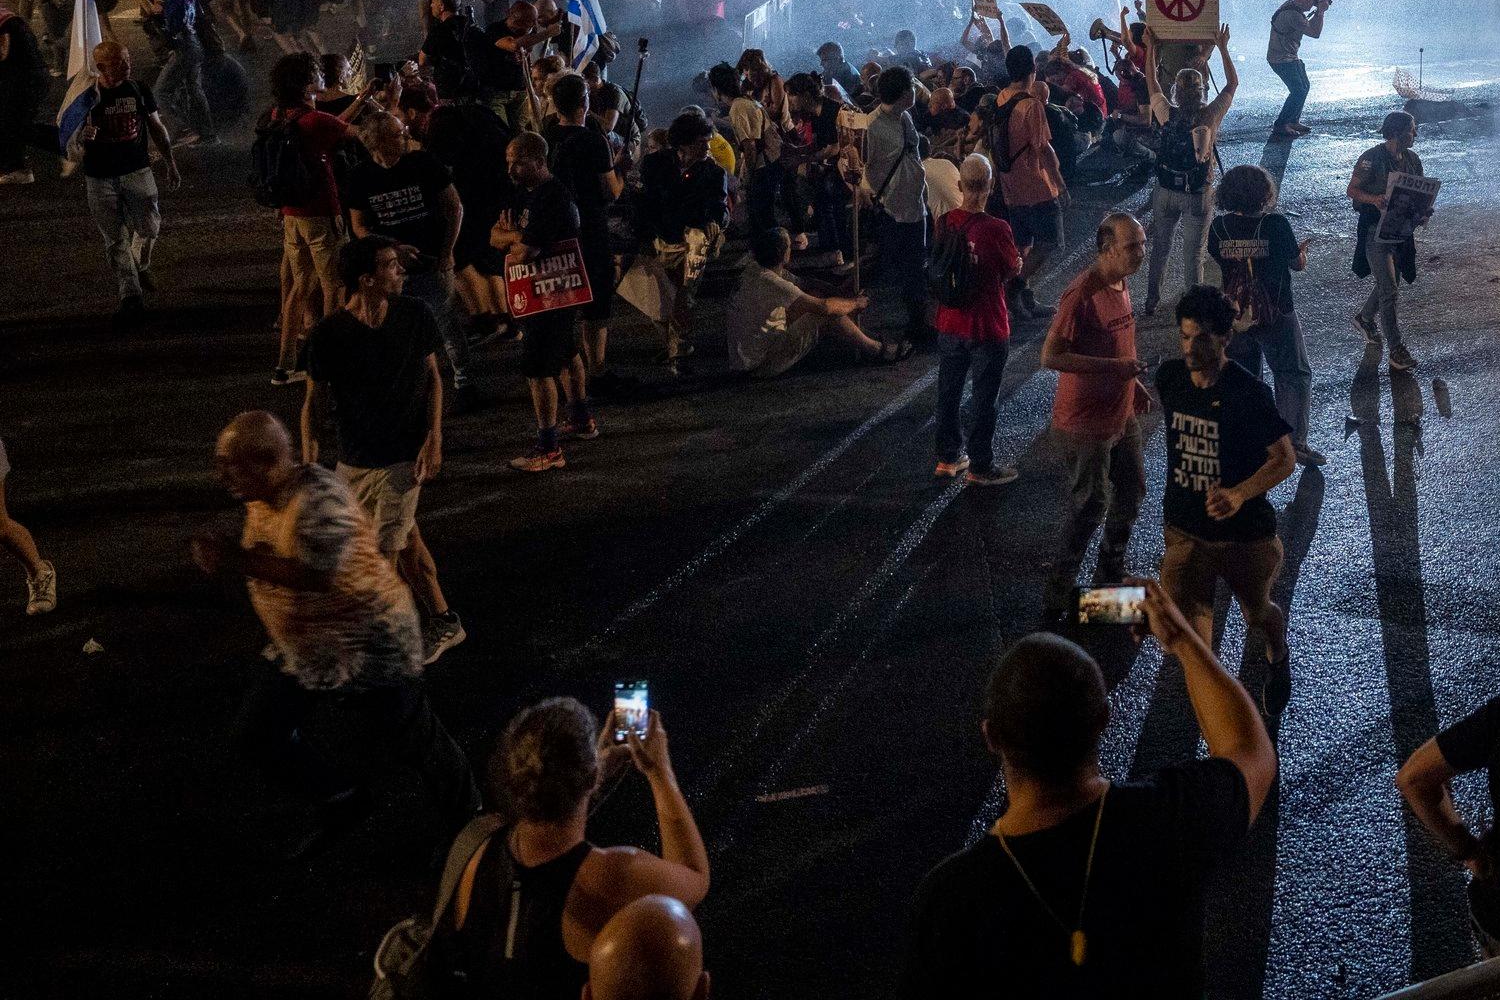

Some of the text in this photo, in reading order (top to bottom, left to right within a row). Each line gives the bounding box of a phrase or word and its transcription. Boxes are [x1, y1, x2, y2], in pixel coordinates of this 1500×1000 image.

[541, 252, 578, 275] אנחנו
[535, 274, 582, 295] מלידה
[1172, 411, 1219, 439] בחירות
